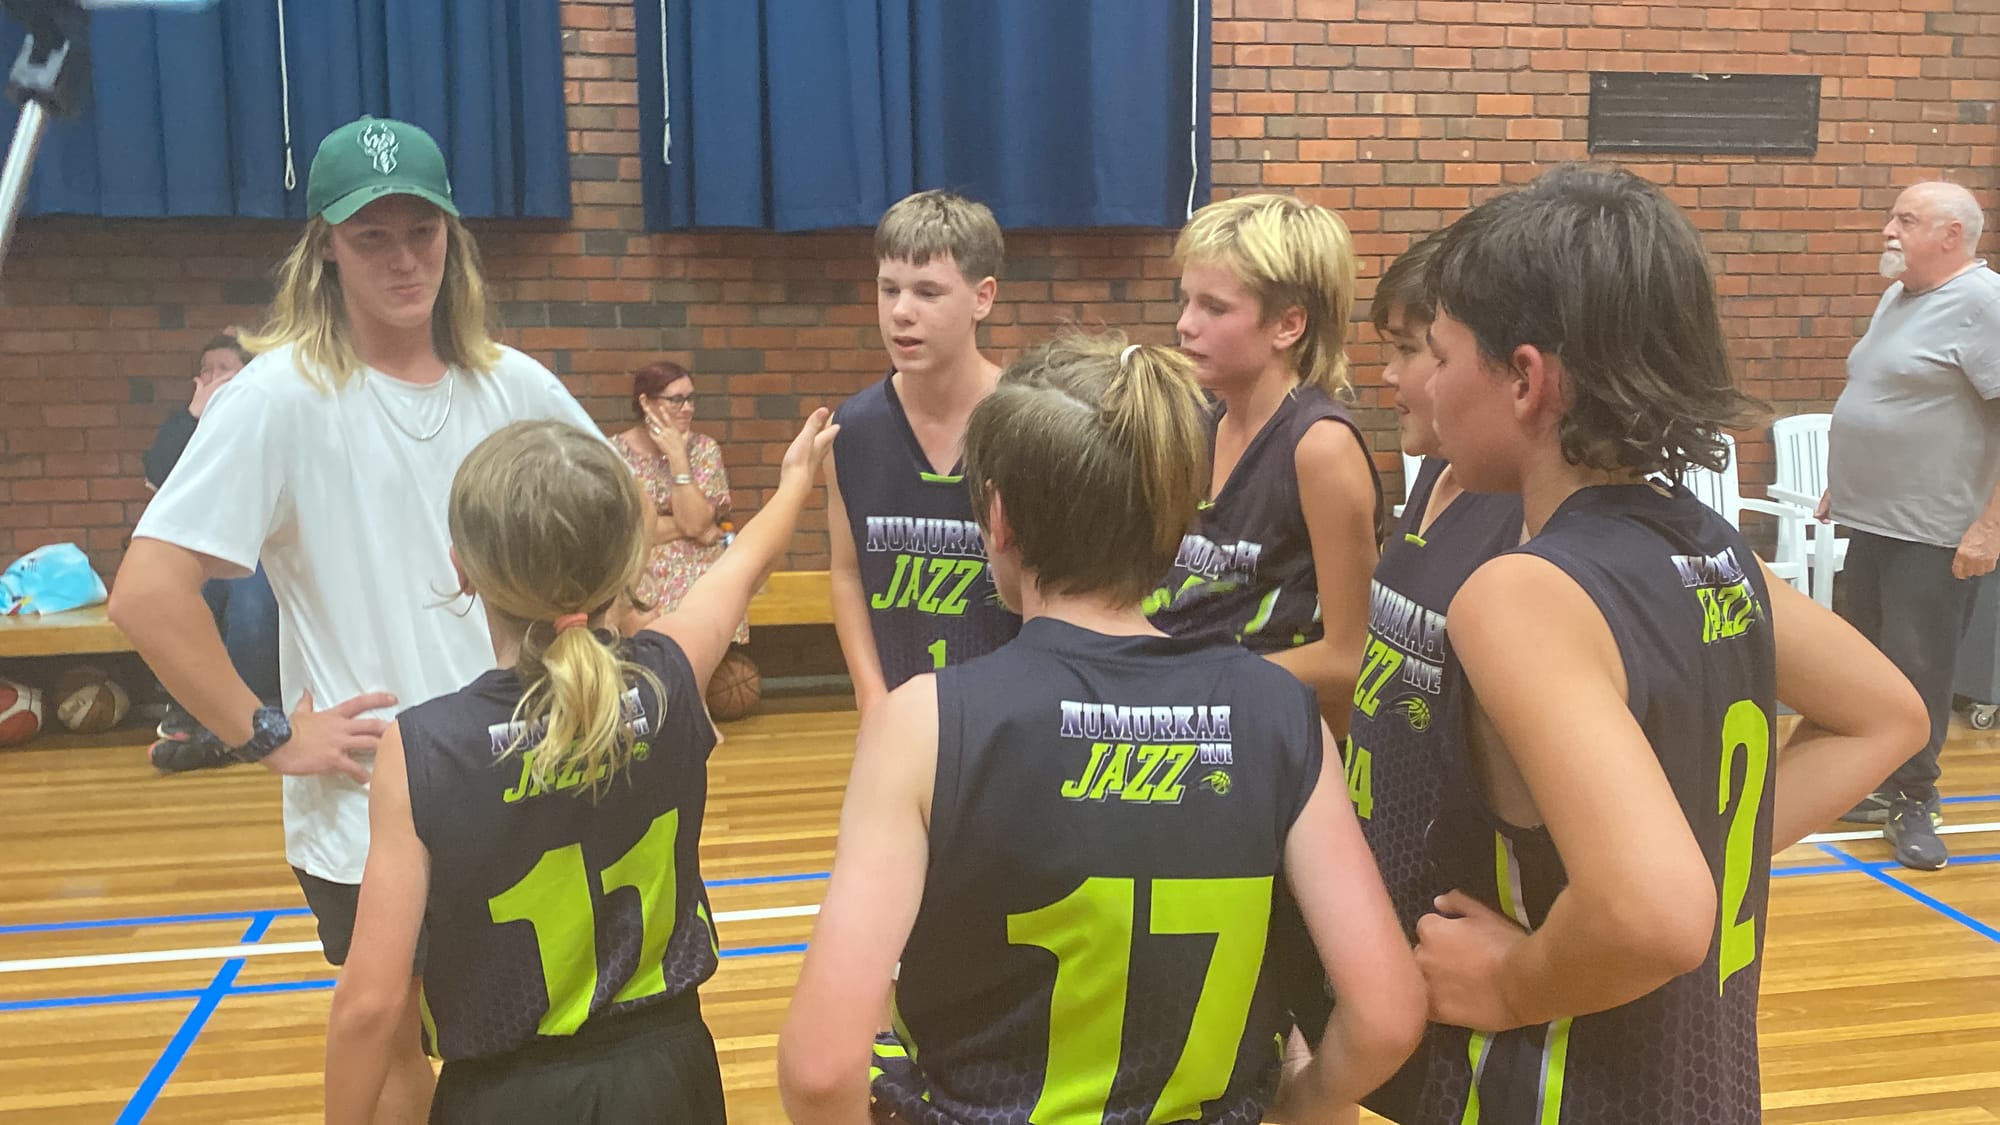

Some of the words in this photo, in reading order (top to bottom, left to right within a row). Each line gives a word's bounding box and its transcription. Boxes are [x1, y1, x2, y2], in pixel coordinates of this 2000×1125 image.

[871, 554, 984, 616] JAZZ
[1402, 655, 1443, 694] BLUE
[1060, 700, 1232, 742] NUMURKAH
[1060, 742, 1200, 804] JAZZ
[1200, 743, 1233, 764] BLUE
[1719, 700, 1769, 997] 2
[488, 808, 679, 1036] 11
[1006, 875, 1274, 1125] 17
